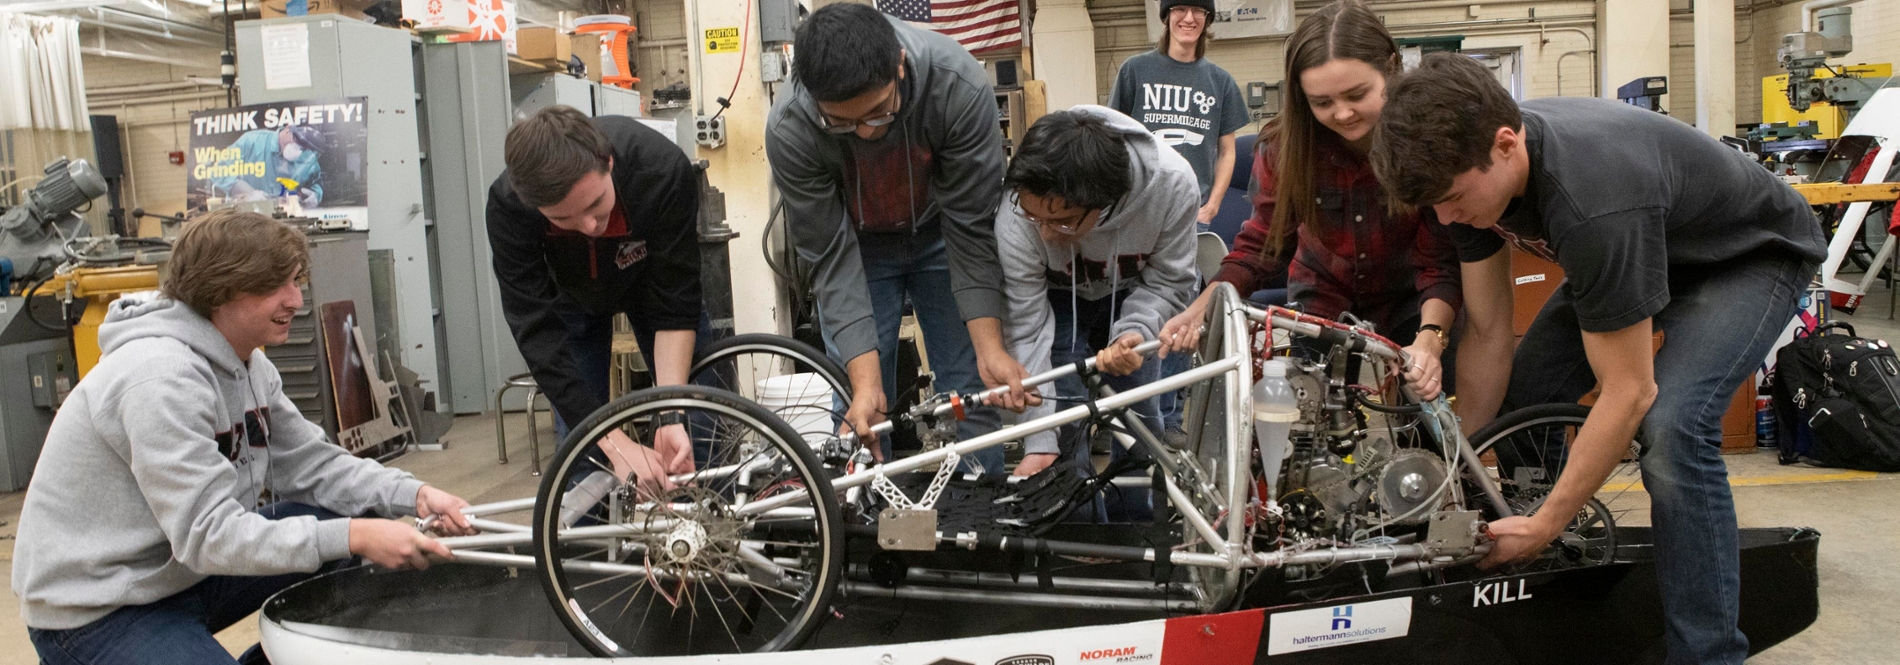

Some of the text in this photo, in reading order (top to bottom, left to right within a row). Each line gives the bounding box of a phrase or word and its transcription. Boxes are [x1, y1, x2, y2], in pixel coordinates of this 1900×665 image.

[707, 28, 737, 38] CAUTION
[1142, 83, 1193, 113] NIU
[194, 103, 363, 136] THINK SAFETY!
[1143, 113, 1211, 130] SUPERMILEAGE
[195, 146, 241, 164] When
[193, 160, 266, 181] Grinding
[1472, 579, 1532, 607] KILL
[1293, 627, 1386, 645] haltermannsolutions
[1080, 646, 1136, 660] NORAM
[1116, 653, 1153, 664] RACING
